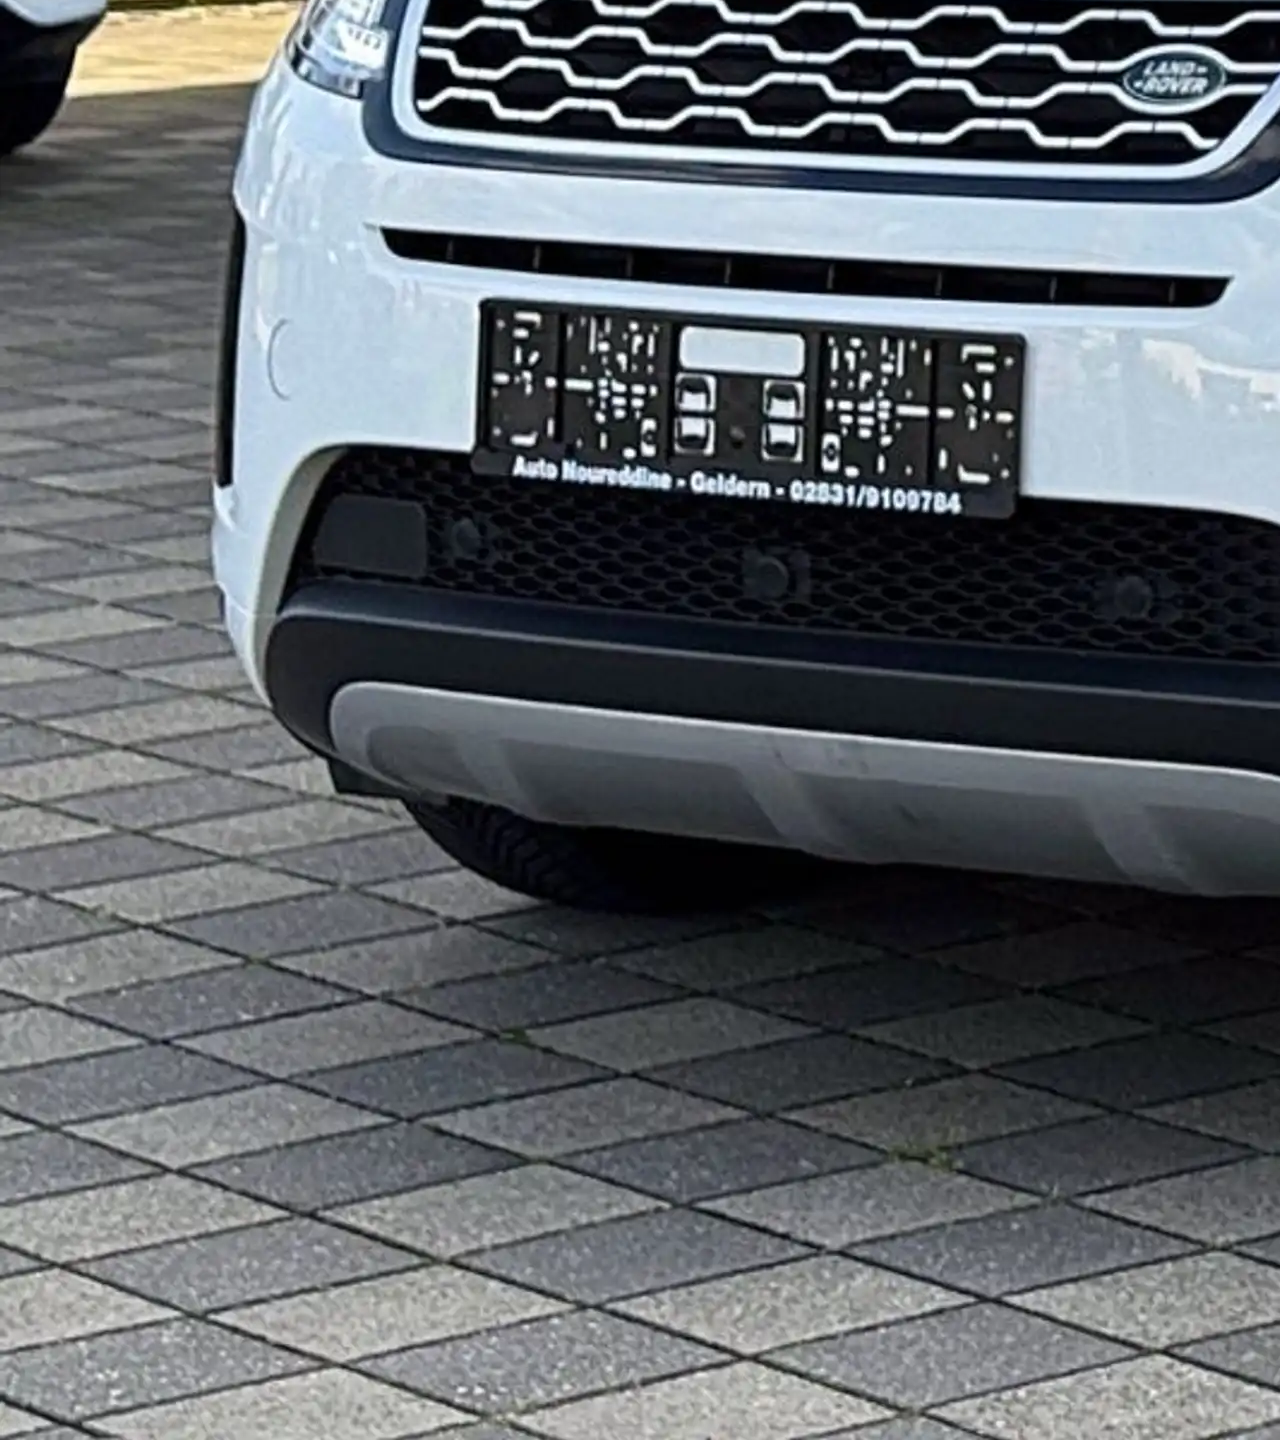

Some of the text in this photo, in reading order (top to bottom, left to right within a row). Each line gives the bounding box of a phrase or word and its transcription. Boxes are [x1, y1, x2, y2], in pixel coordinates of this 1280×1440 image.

[512, 455, 559, 480] Auto
[561, 458, 673, 490] Noureddine
[690, 469, 772, 499] Geldern
